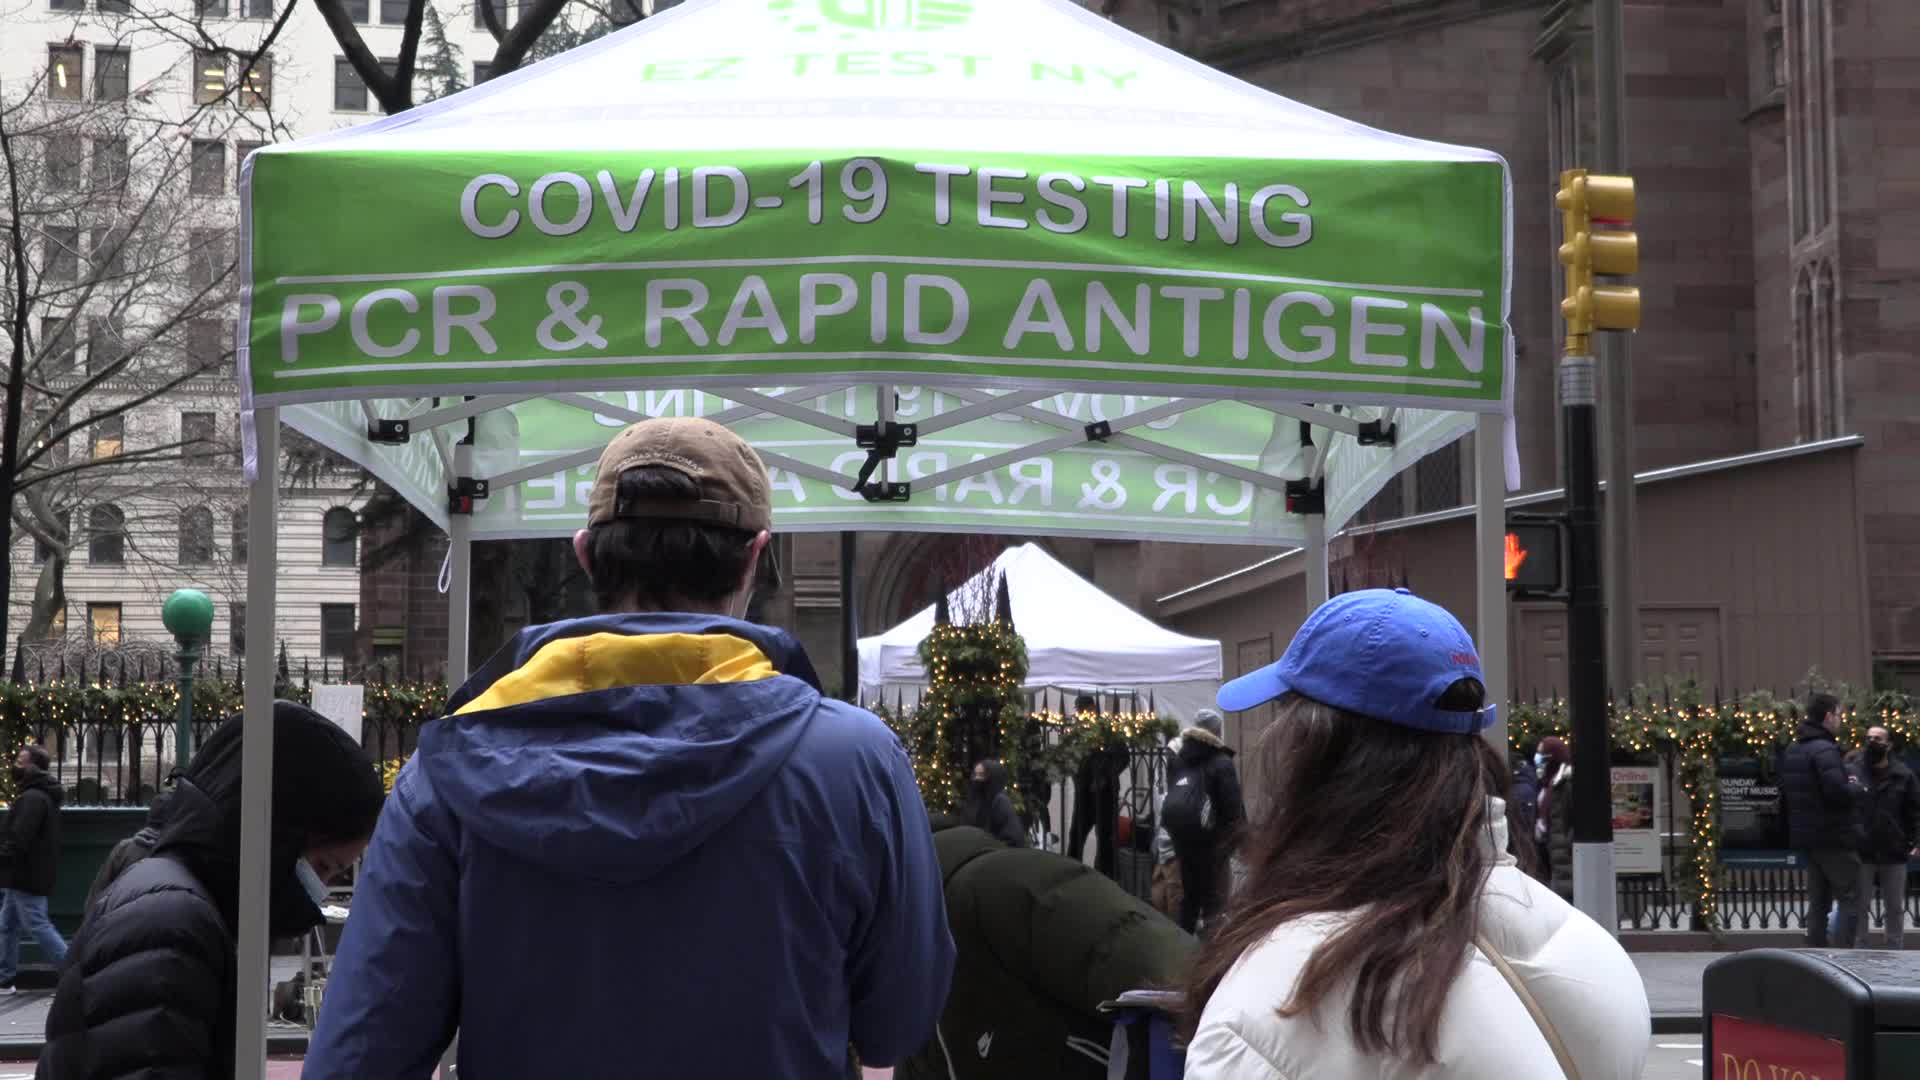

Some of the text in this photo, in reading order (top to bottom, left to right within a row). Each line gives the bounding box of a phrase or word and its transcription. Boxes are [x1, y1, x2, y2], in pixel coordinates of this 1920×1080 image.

[640, 51, 1137, 89] EZ TEST NY
[460, 158, 1313, 248] COVID-19 TESTING
[280, 271, 1484, 373] PCR & RAPID ANTIGEN
[1721, 779, 1757, 787] SUNDAY
[1749, 787, 1779, 796] MUSIC
